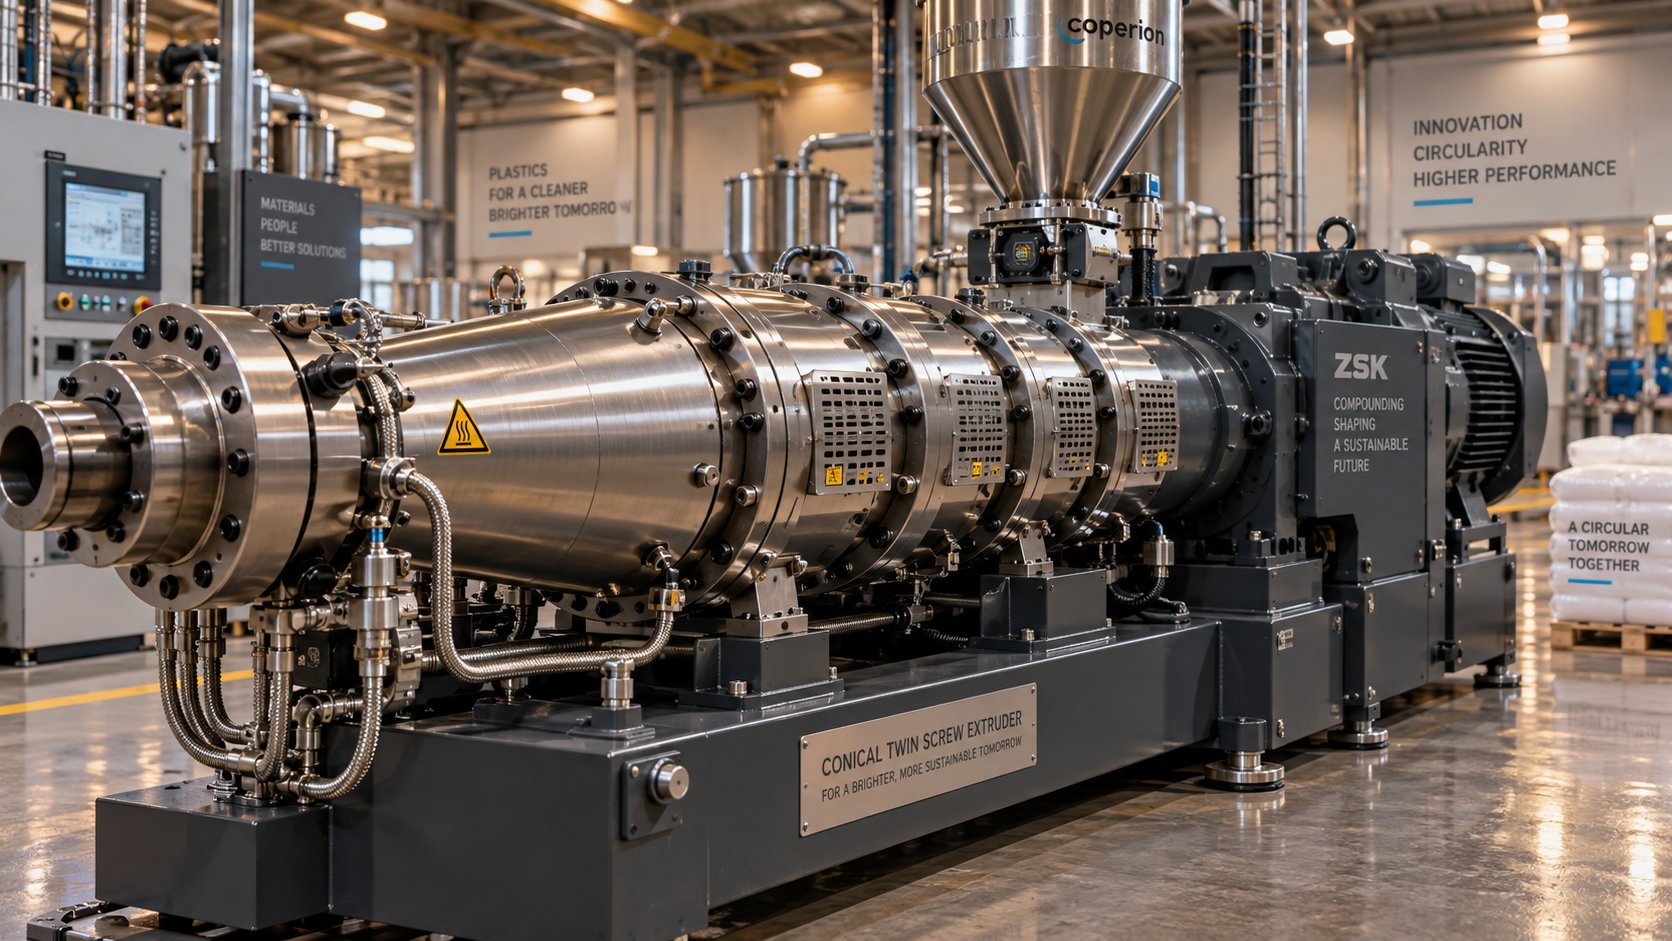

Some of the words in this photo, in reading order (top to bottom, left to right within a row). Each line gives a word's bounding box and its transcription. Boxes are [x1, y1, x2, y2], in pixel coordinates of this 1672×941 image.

[1067, 17, 1165, 46] coperion
[1413, 112, 1523, 136] INNOVATION
[1413, 138, 1528, 161] CIRCULARITY
[489, 163, 548, 180] PLASTICS
[1413, 168, 1479, 187] HIGHER
[1485, 159, 1617, 183] PERFORMANCE
[489, 186, 514, 201] FOR
[518, 185, 527, 200] A
[530, 181, 589, 198] CLEANER
[260, 196, 316, 216] MATERIALS
[489, 205, 550, 222] BRIGHTER
[260, 217, 298, 234] PEOPLE
[260, 238, 296, 254] BETTER
[297, 242, 347, 259] SOLUTIONS
[1334, 352, 1389, 380] ZSK
[1333, 396, 1405, 411] COMPOUNDING
[1333, 417, 1376, 432] SHAPING
[1333, 438, 1341, 452] A
[1343, 437, 1409, 452] SUSTAINABLE
[1333, 458, 1370, 473] FUTURE
[1568, 521, 1577, 533] A
[1581, 521, 1649, 535] CIRCULAR
[1568, 538, 1650, 554] TOMORROW
[1568, 557, 1640, 572] TOGETHER
[821, 745, 883, 776] CONICAL
[886, 735, 919, 759] TWIN
[923, 724, 964, 750] SCREW
[967, 710, 1022, 738] EXTRUDER
[821, 785, 841, 802] FOR
[843, 783, 850, 796] A
[852, 770, 898, 793] BRIGHTER,
[899, 762, 923, 780] MORE
[925, 747, 977, 772] SUSTAINABLE
[979, 735, 1023, 757] TOMORROW
